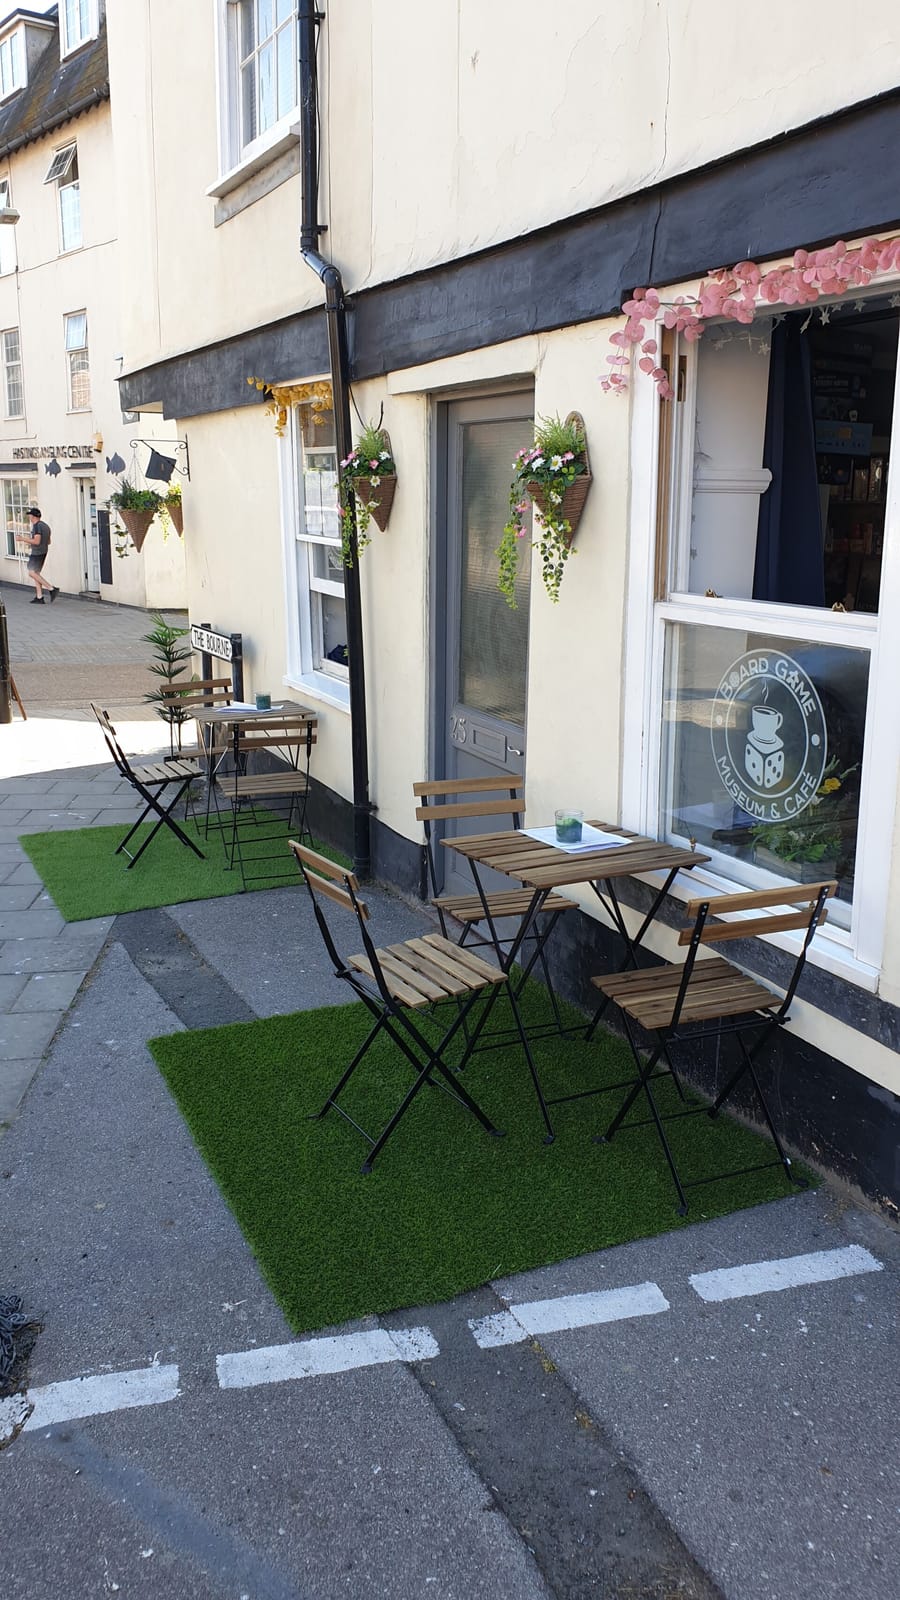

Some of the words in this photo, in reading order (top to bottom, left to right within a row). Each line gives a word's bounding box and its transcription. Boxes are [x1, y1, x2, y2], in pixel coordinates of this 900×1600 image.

[13, 447, 40, 459] HASTINGS
[40, 446, 67, 459] ANGLING
[68, 445, 94, 459] CENTRE
[194, 630, 204, 648] THE
[206, 634, 230, 657] BOURNE
[720, 657, 769, 701] BOARD
[775, 659, 816, 717] GAME
[718, 755, 765, 818] MUSEUM
[770, 802, 781, 820] &
